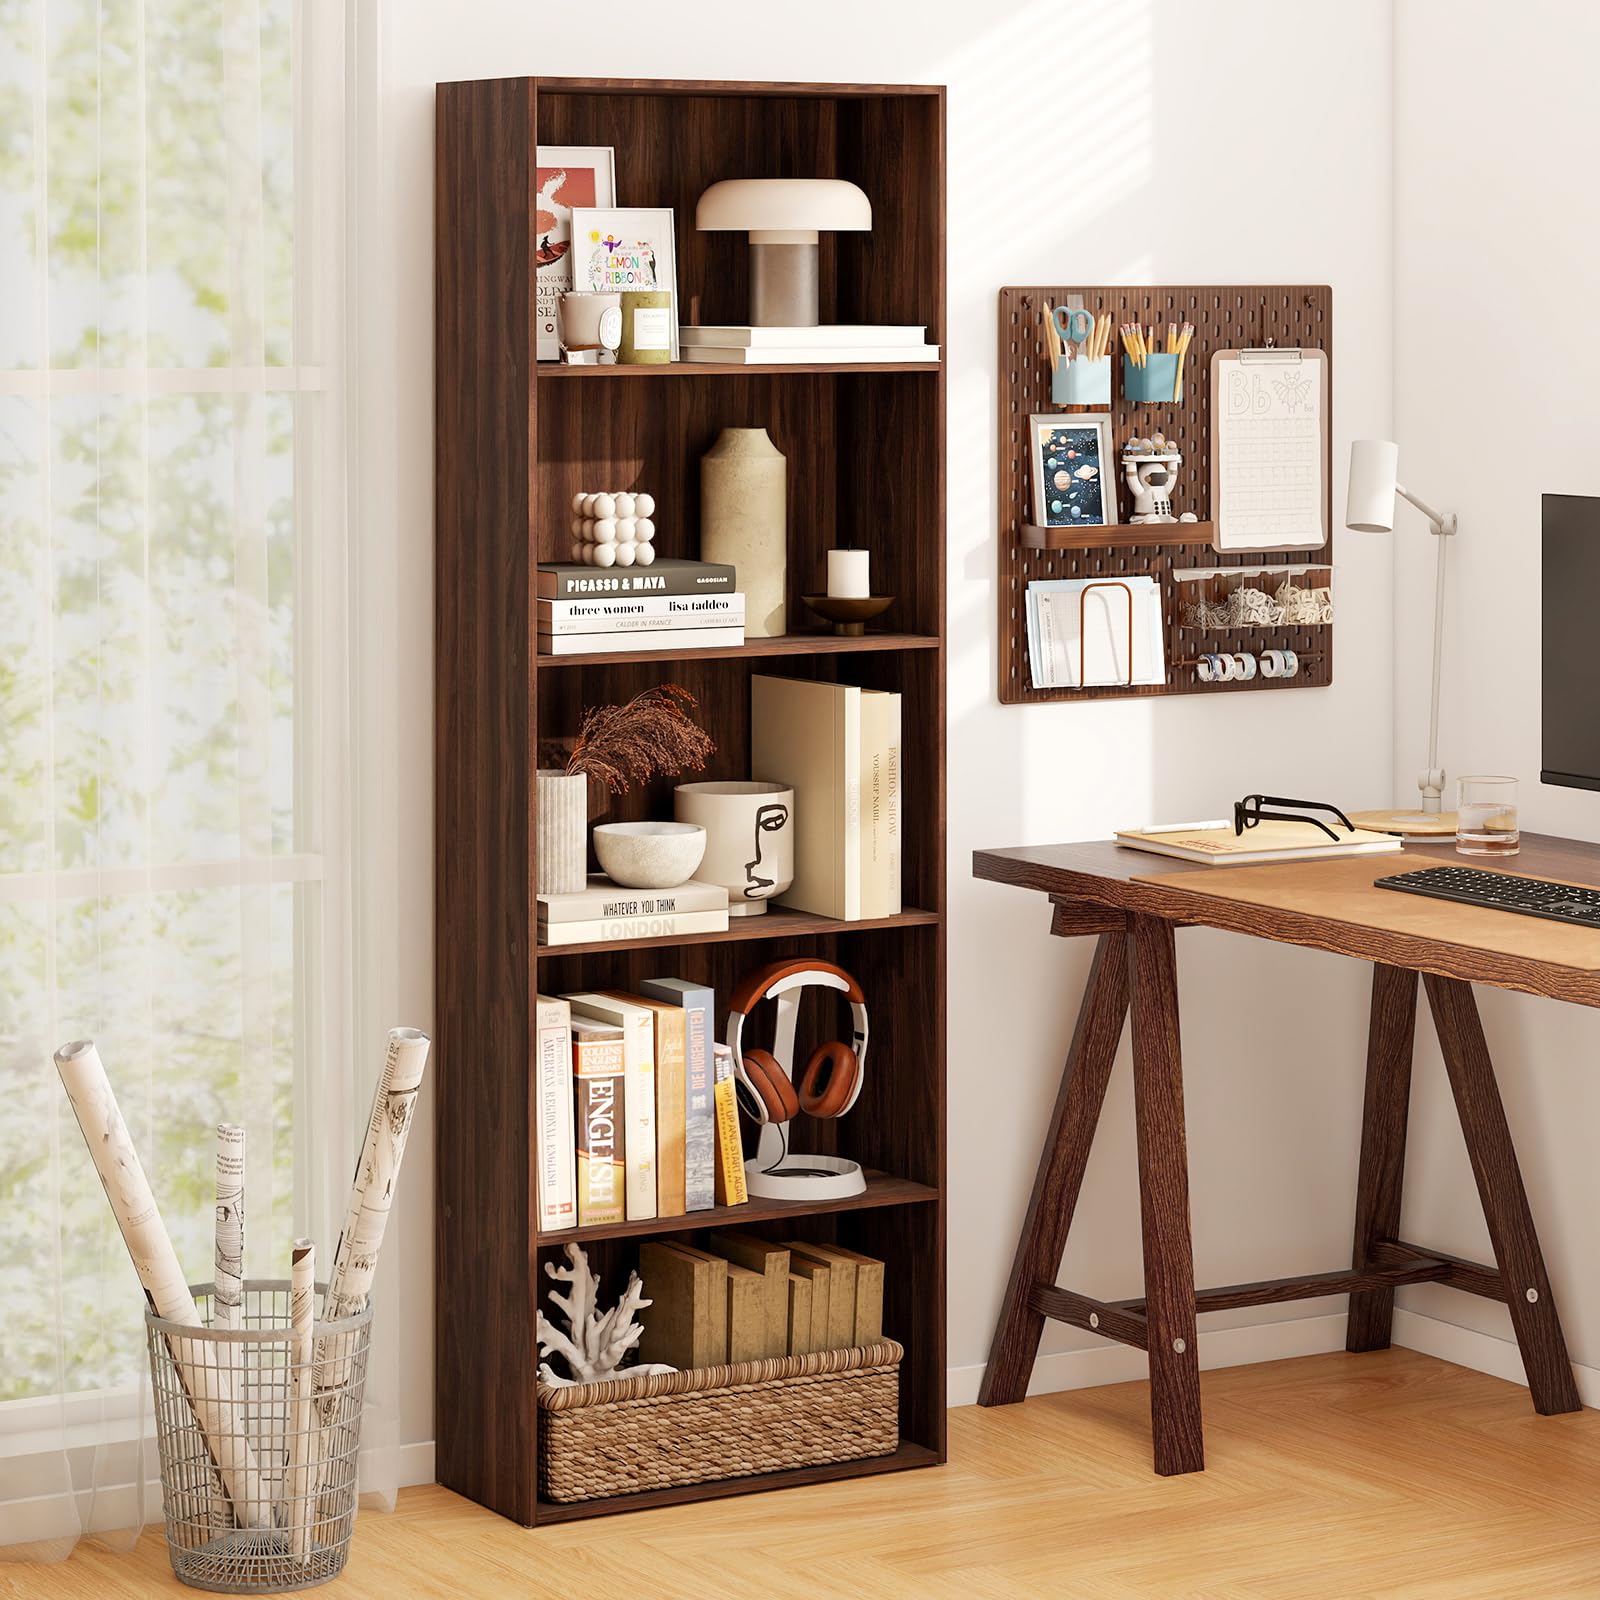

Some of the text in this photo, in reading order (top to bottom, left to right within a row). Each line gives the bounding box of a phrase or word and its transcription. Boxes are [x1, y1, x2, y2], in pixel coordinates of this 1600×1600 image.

[605, 256, 640, 269] LEMON
[605, 271, 642, 284] RIBBON
[567, 576, 728, 593] PICASSO & MAYA GAGOSIAN
[569, 599, 729, 616] three women lisa taddeo
[615, 619, 640, 628] CALDER
[648, 619, 672, 627] FRANCE
[888, 747, 897, 836] FASHION SHOW
[602, 898, 676, 917] WHATEVER YOU THINK
[601, 919, 676, 939] LONDON
[691, 1073, 706, 1089] DIE
[544, 1038, 557, 1187] AMERICAN REGIONAL ENGLISH
[726, 1110, 735, 1123] UP
[589, 1079, 614, 1204] ENGLISH
[730, 1146, 741, 1173] START
[734, 1175, 745, 1204] AGAIN
